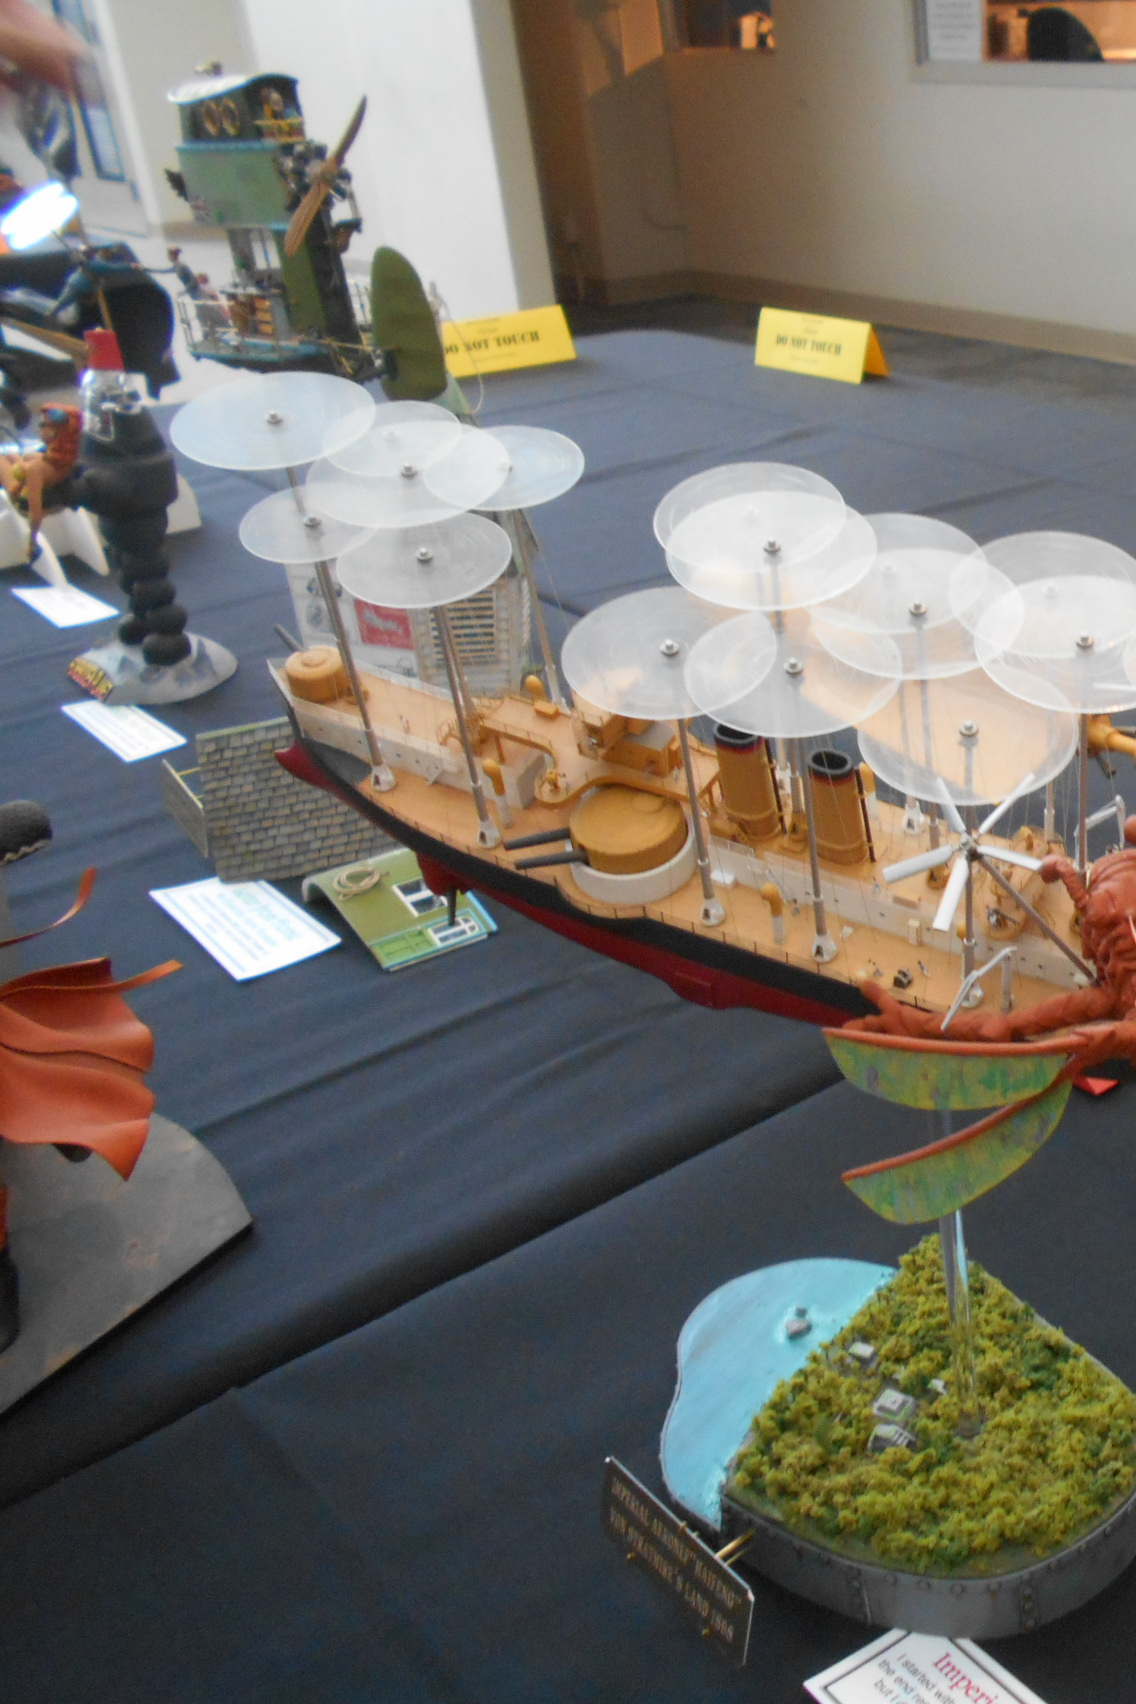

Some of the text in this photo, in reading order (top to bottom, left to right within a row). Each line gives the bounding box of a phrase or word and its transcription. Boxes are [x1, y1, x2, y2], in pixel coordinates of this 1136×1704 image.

[463, 338, 489, 352] NOT
[495, 330, 540, 347] TOUCH
[775, 334, 842, 356] DO NOT TOUCH
[879, 1659, 896, 1677] the
[894, 1676, 915, 1695] end
[902, 1660, 937, 1692] started
[874, 1678, 894, 1697] but
